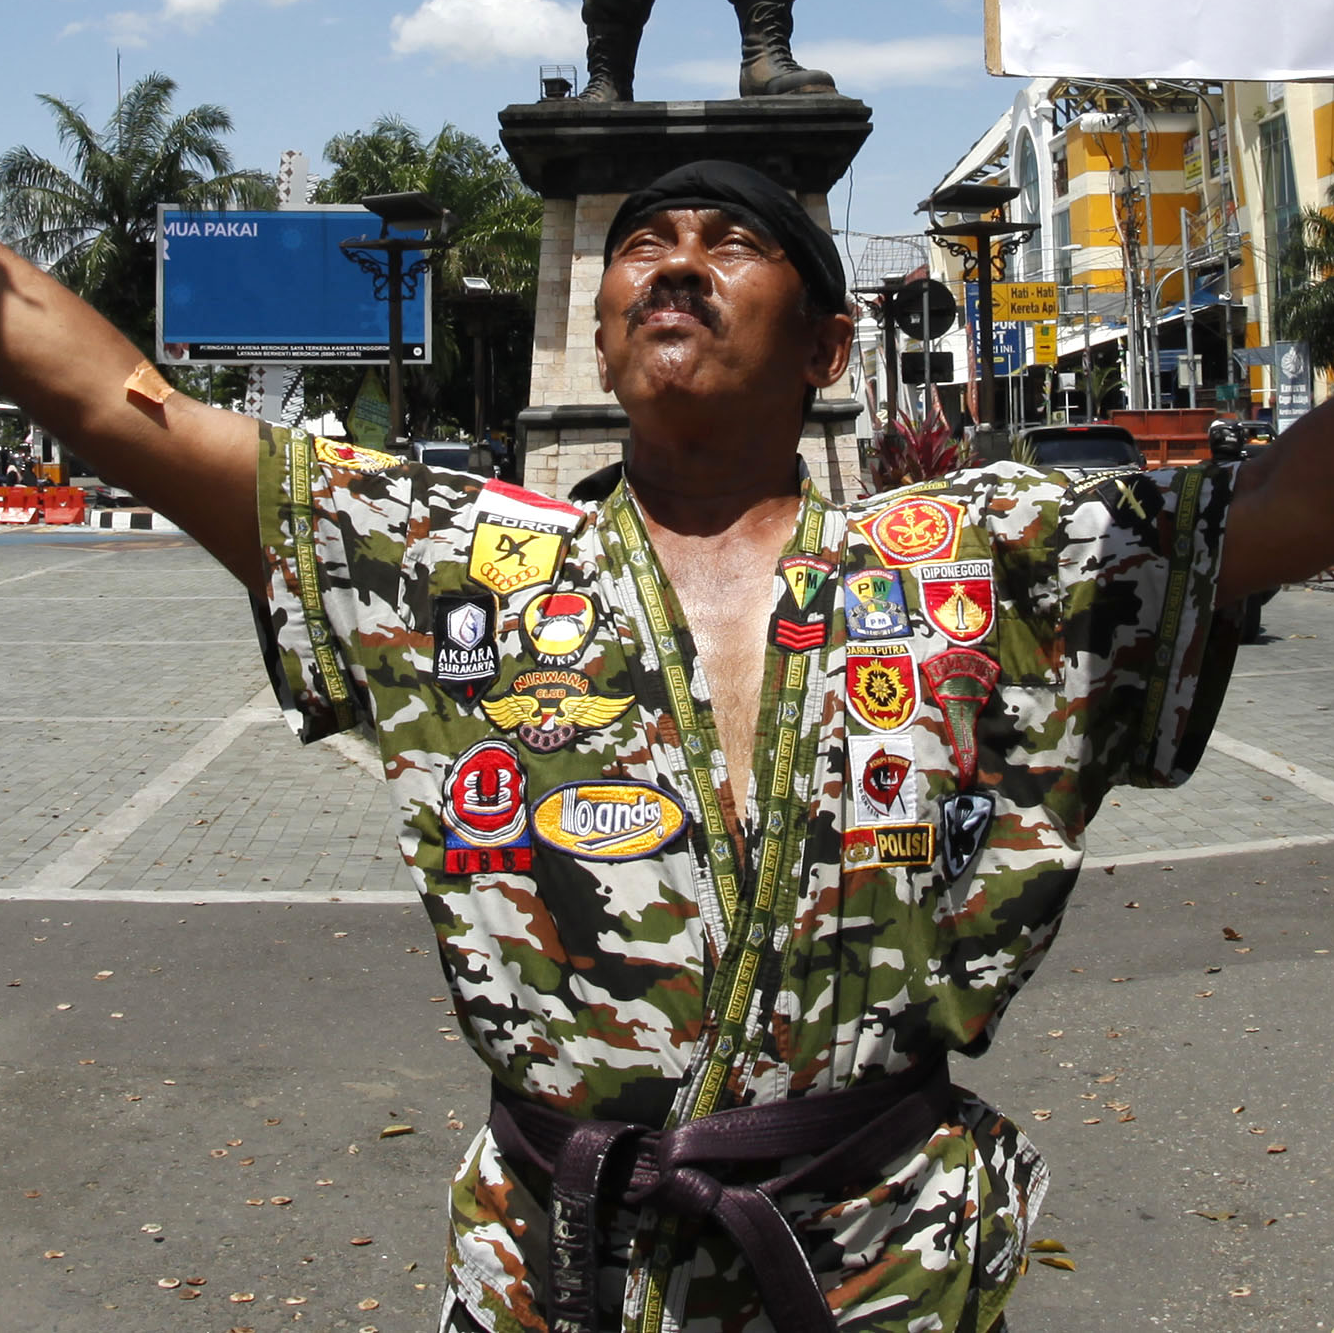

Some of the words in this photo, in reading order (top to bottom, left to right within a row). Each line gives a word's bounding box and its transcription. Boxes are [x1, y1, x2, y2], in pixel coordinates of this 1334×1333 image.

[205, 222, 258, 237] PAKAI
[1011, 288, 1029, 299] Hati
[1036, 286, 1055, 298] Hati
[1011, 304, 1039, 314] Kereta
[1042, 302, 1057, 314] Api
[296, 467, 306, 501] MILITER
[485, 514, 558, 534] FORKI
[923, 564, 989, 579] DIPONEGORO
[438, 646, 495, 664] AKBARA
[438, 660, 495, 674] SURAKARTA
[537, 650, 583, 666] INKAI
[513, 671, 589, 694] NIRWANA
[535, 688, 567, 699] CLUB
[669, 666, 686, 701] MILITER
[678, 700, 693, 728] POLISI
[779, 730, 794, 757] POLISI
[696, 768, 714, 804] MILITER
[773, 757, 790, 794] MILITER
[706, 804, 721, 833] POLISI
[763, 840, 778, 869] POLISI
[877, 832, 927, 858] POLISI
[455, 848, 519, 873] UBB
[757, 869, 774, 907] MILITER
[738, 952, 756, 982] POLISI
[728, 981, 748, 1020] MILITER
[703, 1063, 724, 1093] POLISI
